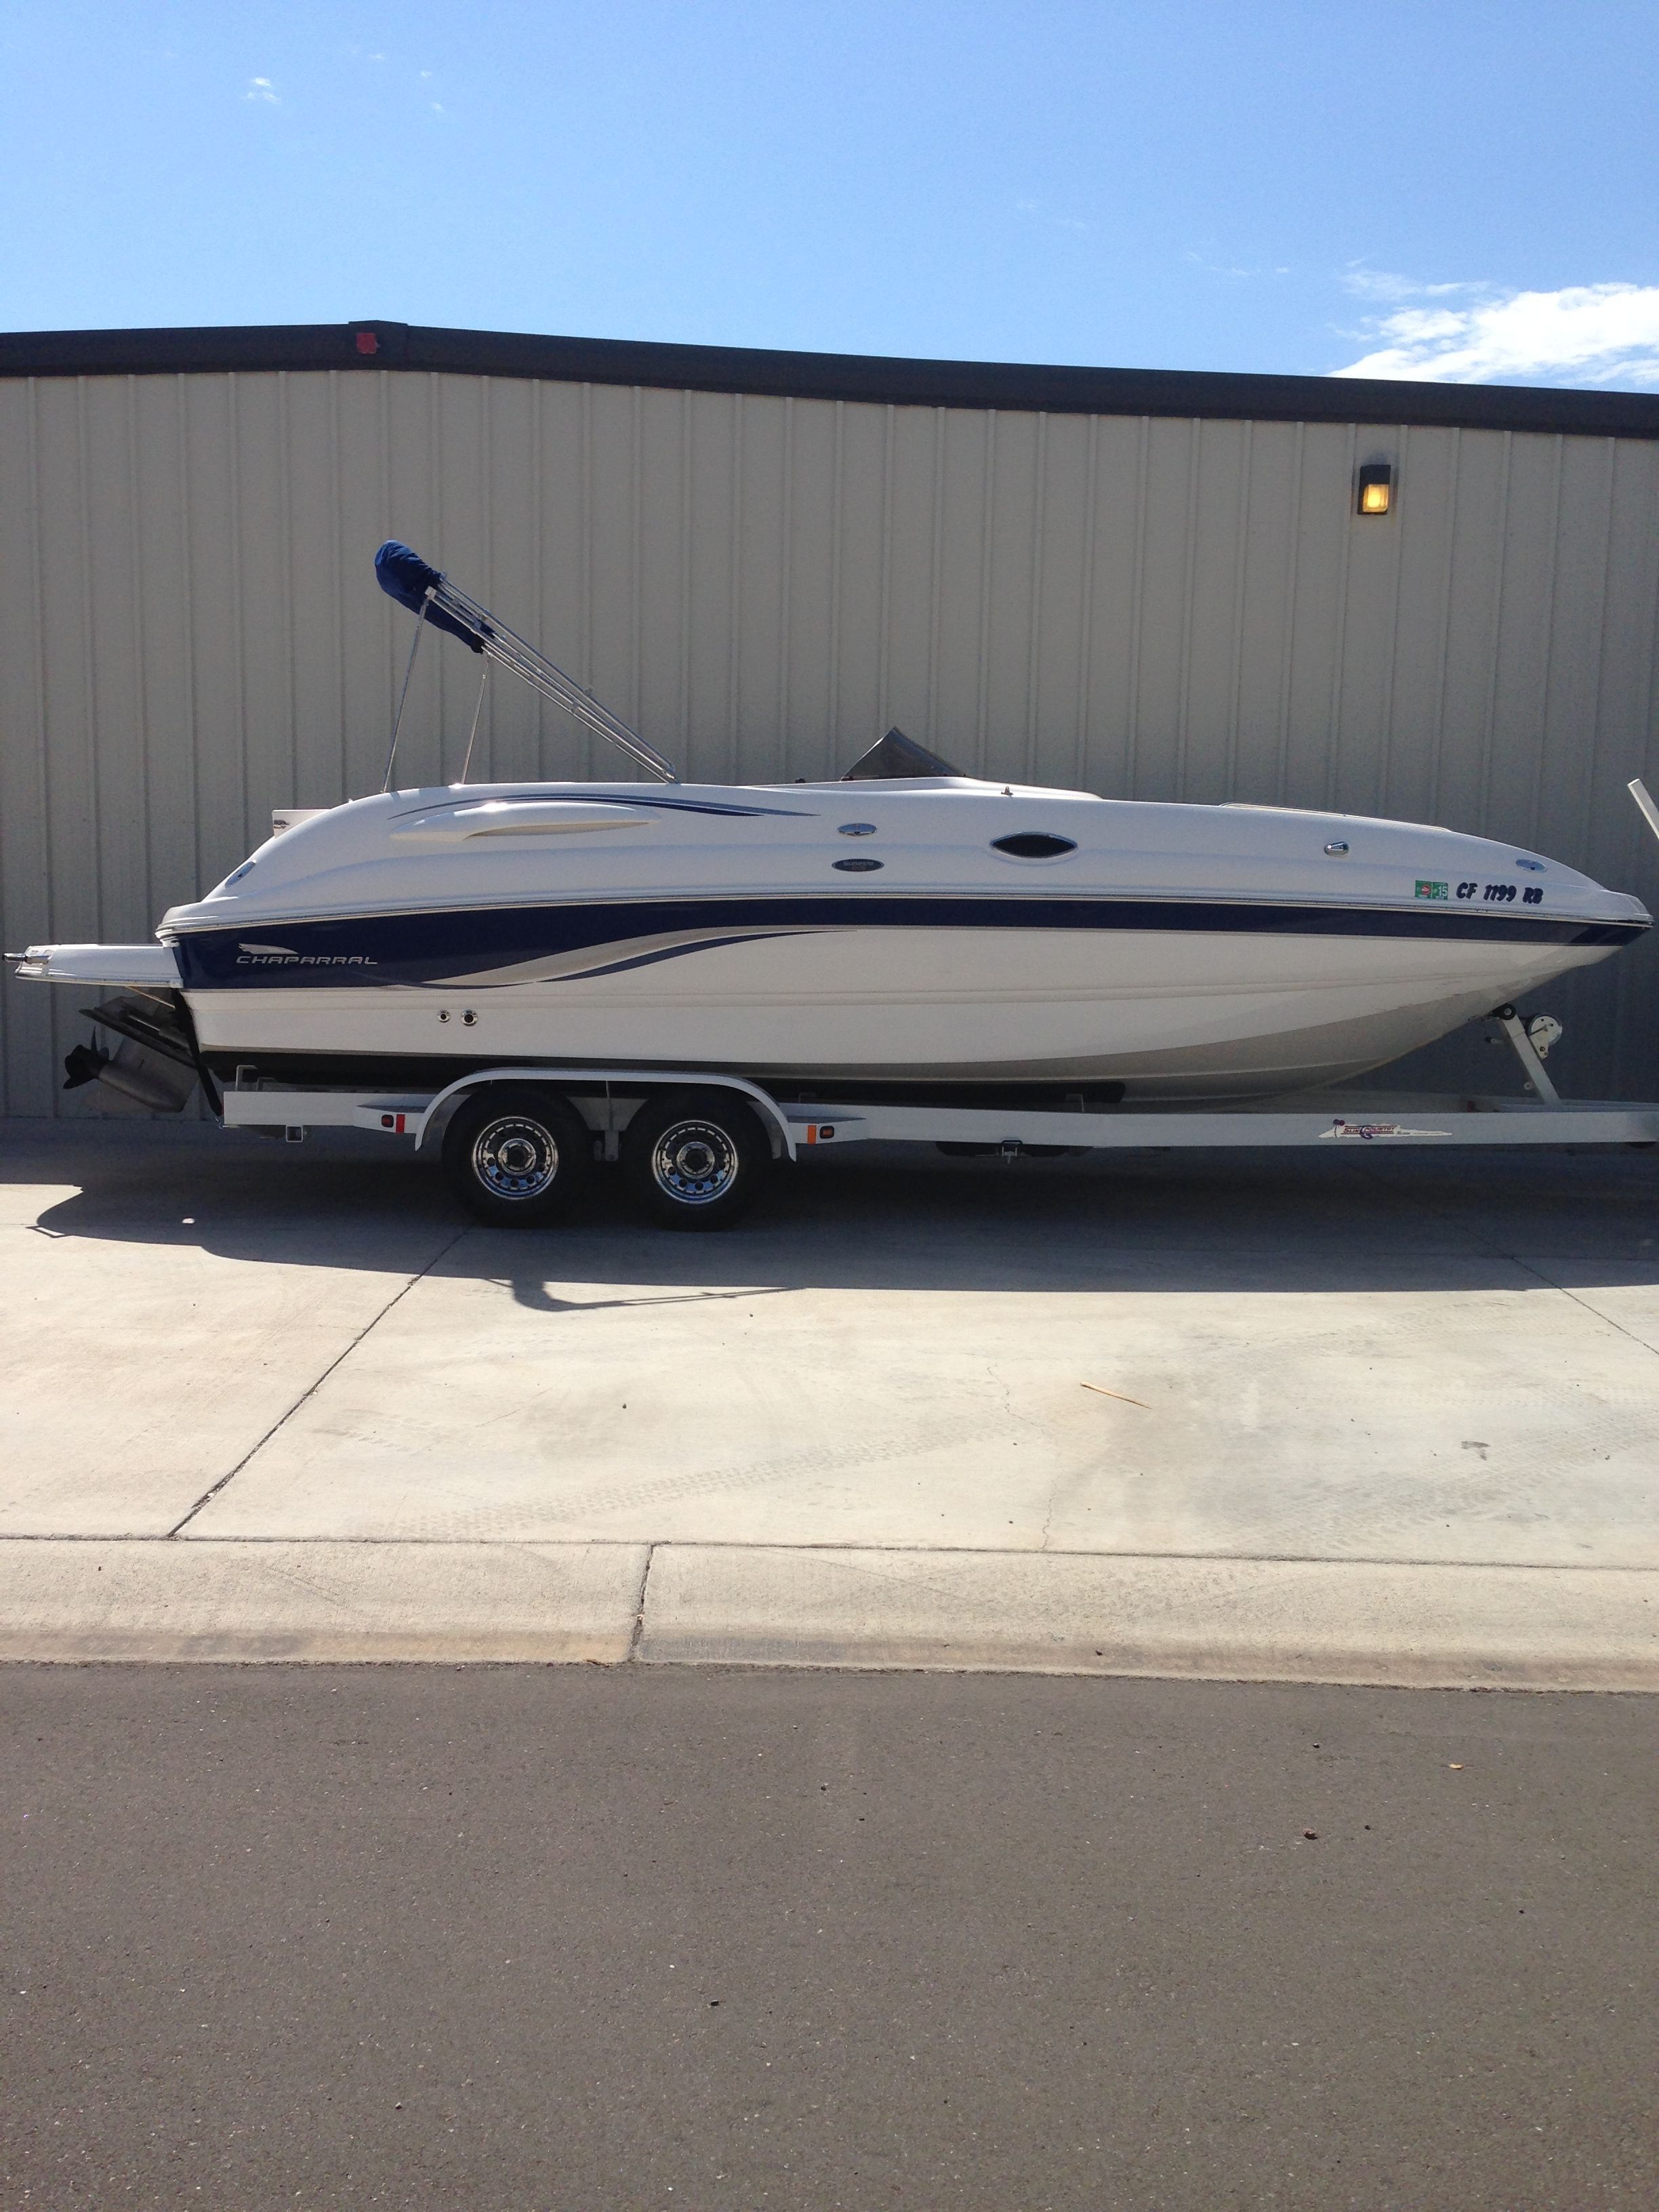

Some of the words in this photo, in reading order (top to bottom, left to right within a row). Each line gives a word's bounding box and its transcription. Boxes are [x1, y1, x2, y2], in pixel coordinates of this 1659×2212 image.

[1438, 885, 1448, 897] 15
[1456, 882, 1478, 899] CF
[1483, 884, 1517, 902] 1199
[1522, 887, 1543, 904] RB
[236, 956, 378, 965] CHAPARRAL
